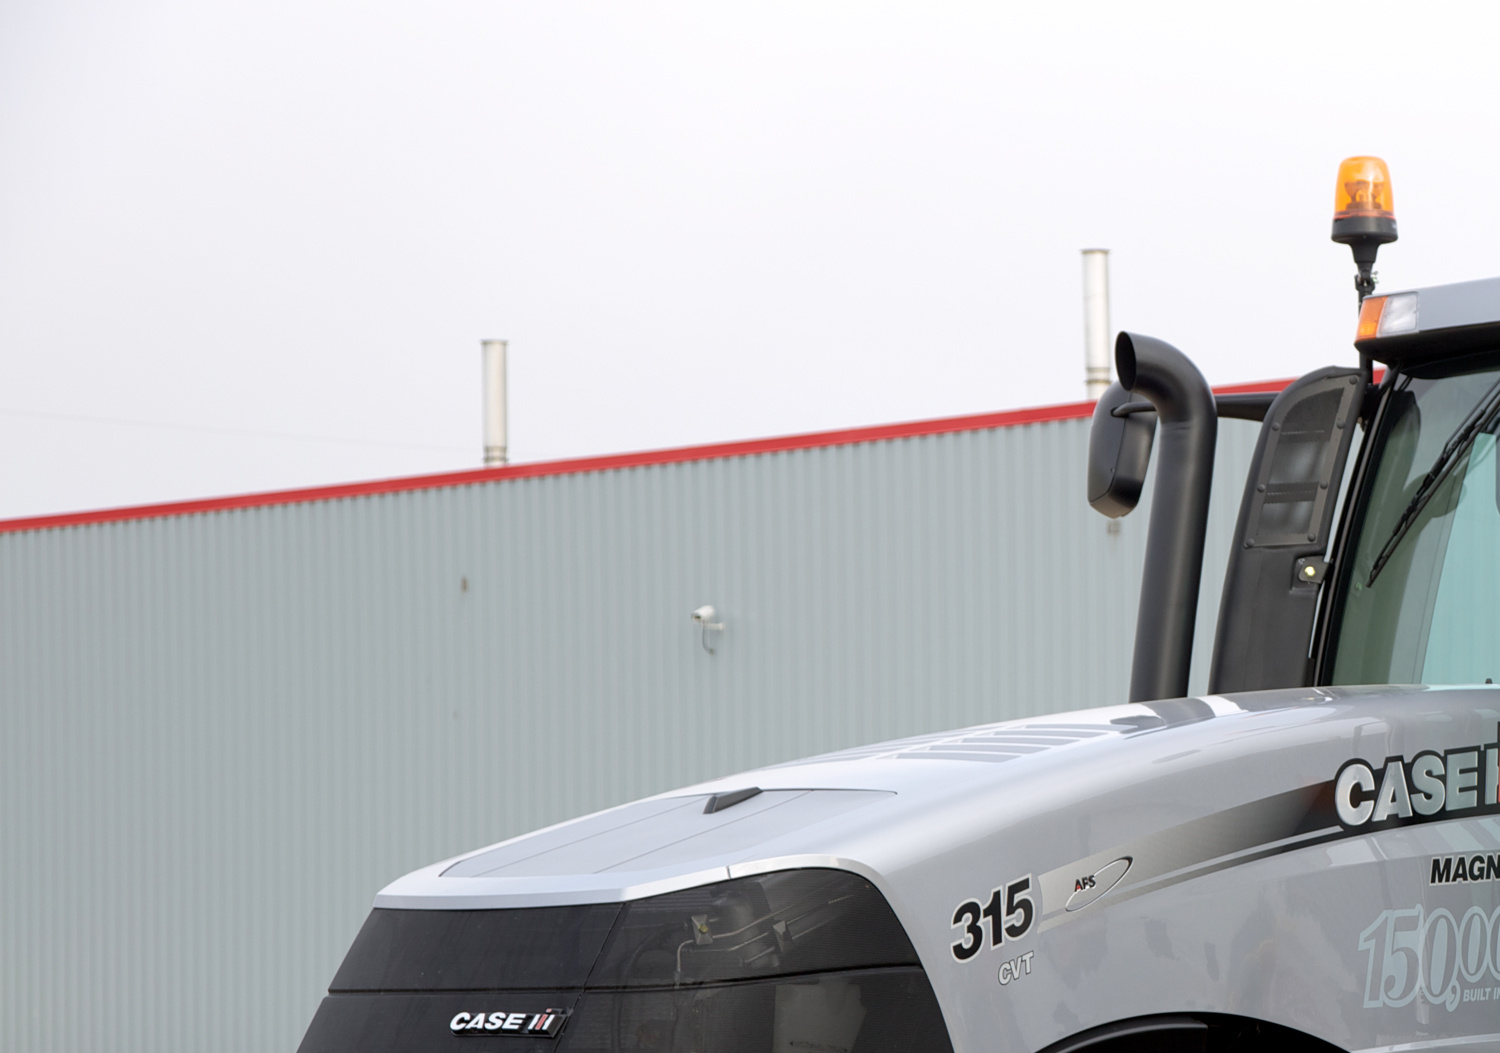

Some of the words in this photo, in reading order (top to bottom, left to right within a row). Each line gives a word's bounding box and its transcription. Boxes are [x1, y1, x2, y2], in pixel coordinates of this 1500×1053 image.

[1335, 751, 1478, 826] CASE
[1074, 875, 1096, 893] AFS
[951, 876, 1035, 962] 315
[998, 950, 1034, 986] CVT
[1463, 987, 1491, 1002] BUILT
[450, 1012, 526, 1031] CASE
